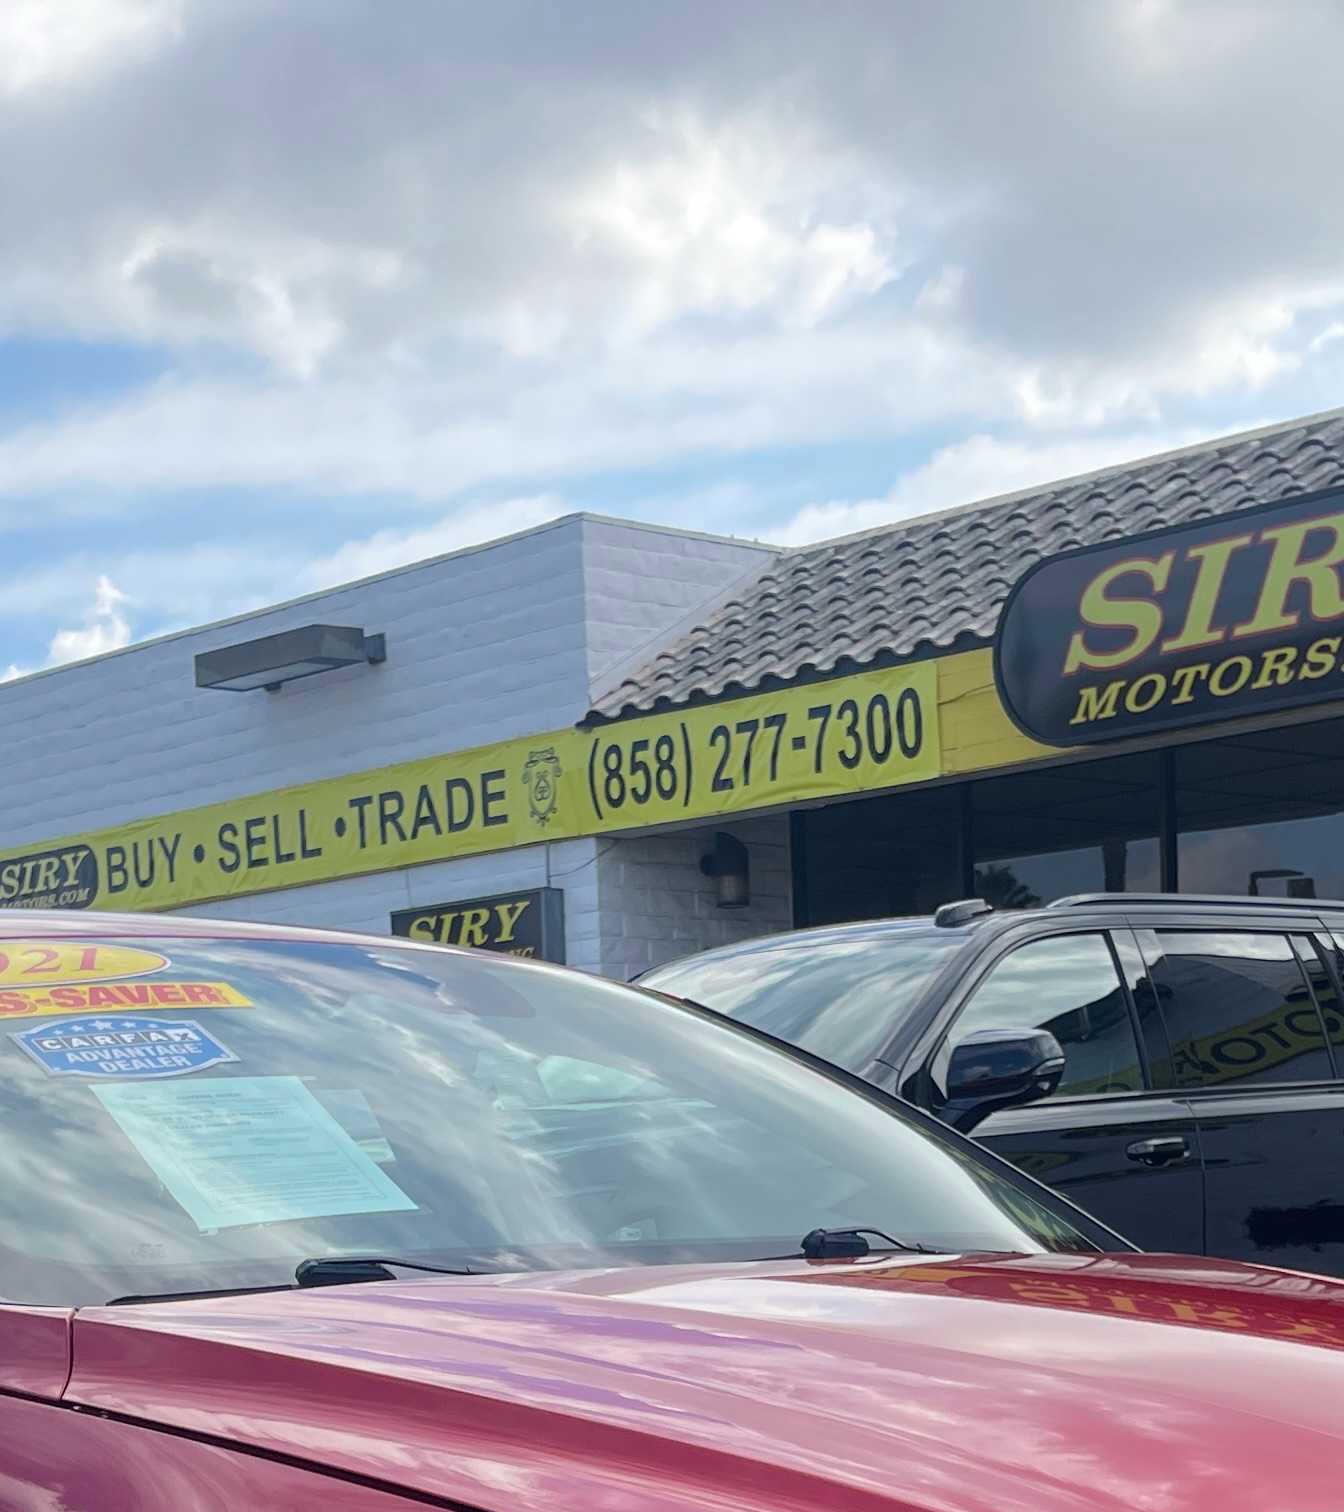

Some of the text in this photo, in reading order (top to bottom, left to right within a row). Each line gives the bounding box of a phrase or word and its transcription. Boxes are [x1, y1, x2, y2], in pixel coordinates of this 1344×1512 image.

[588, 687, 923, 820] (858) 277-7300
[106, 833, 182, 894] BUY
[217, 809, 322, 874] SELL
[348, 769, 508, 850] TRADE
[409, 900, 531, 948] SIRY
[40, 1029, 201, 1050] CARFAX
[66, 1042, 203, 1064] ADVANTAGE
[98, 1056, 192, 1073] DEALER
